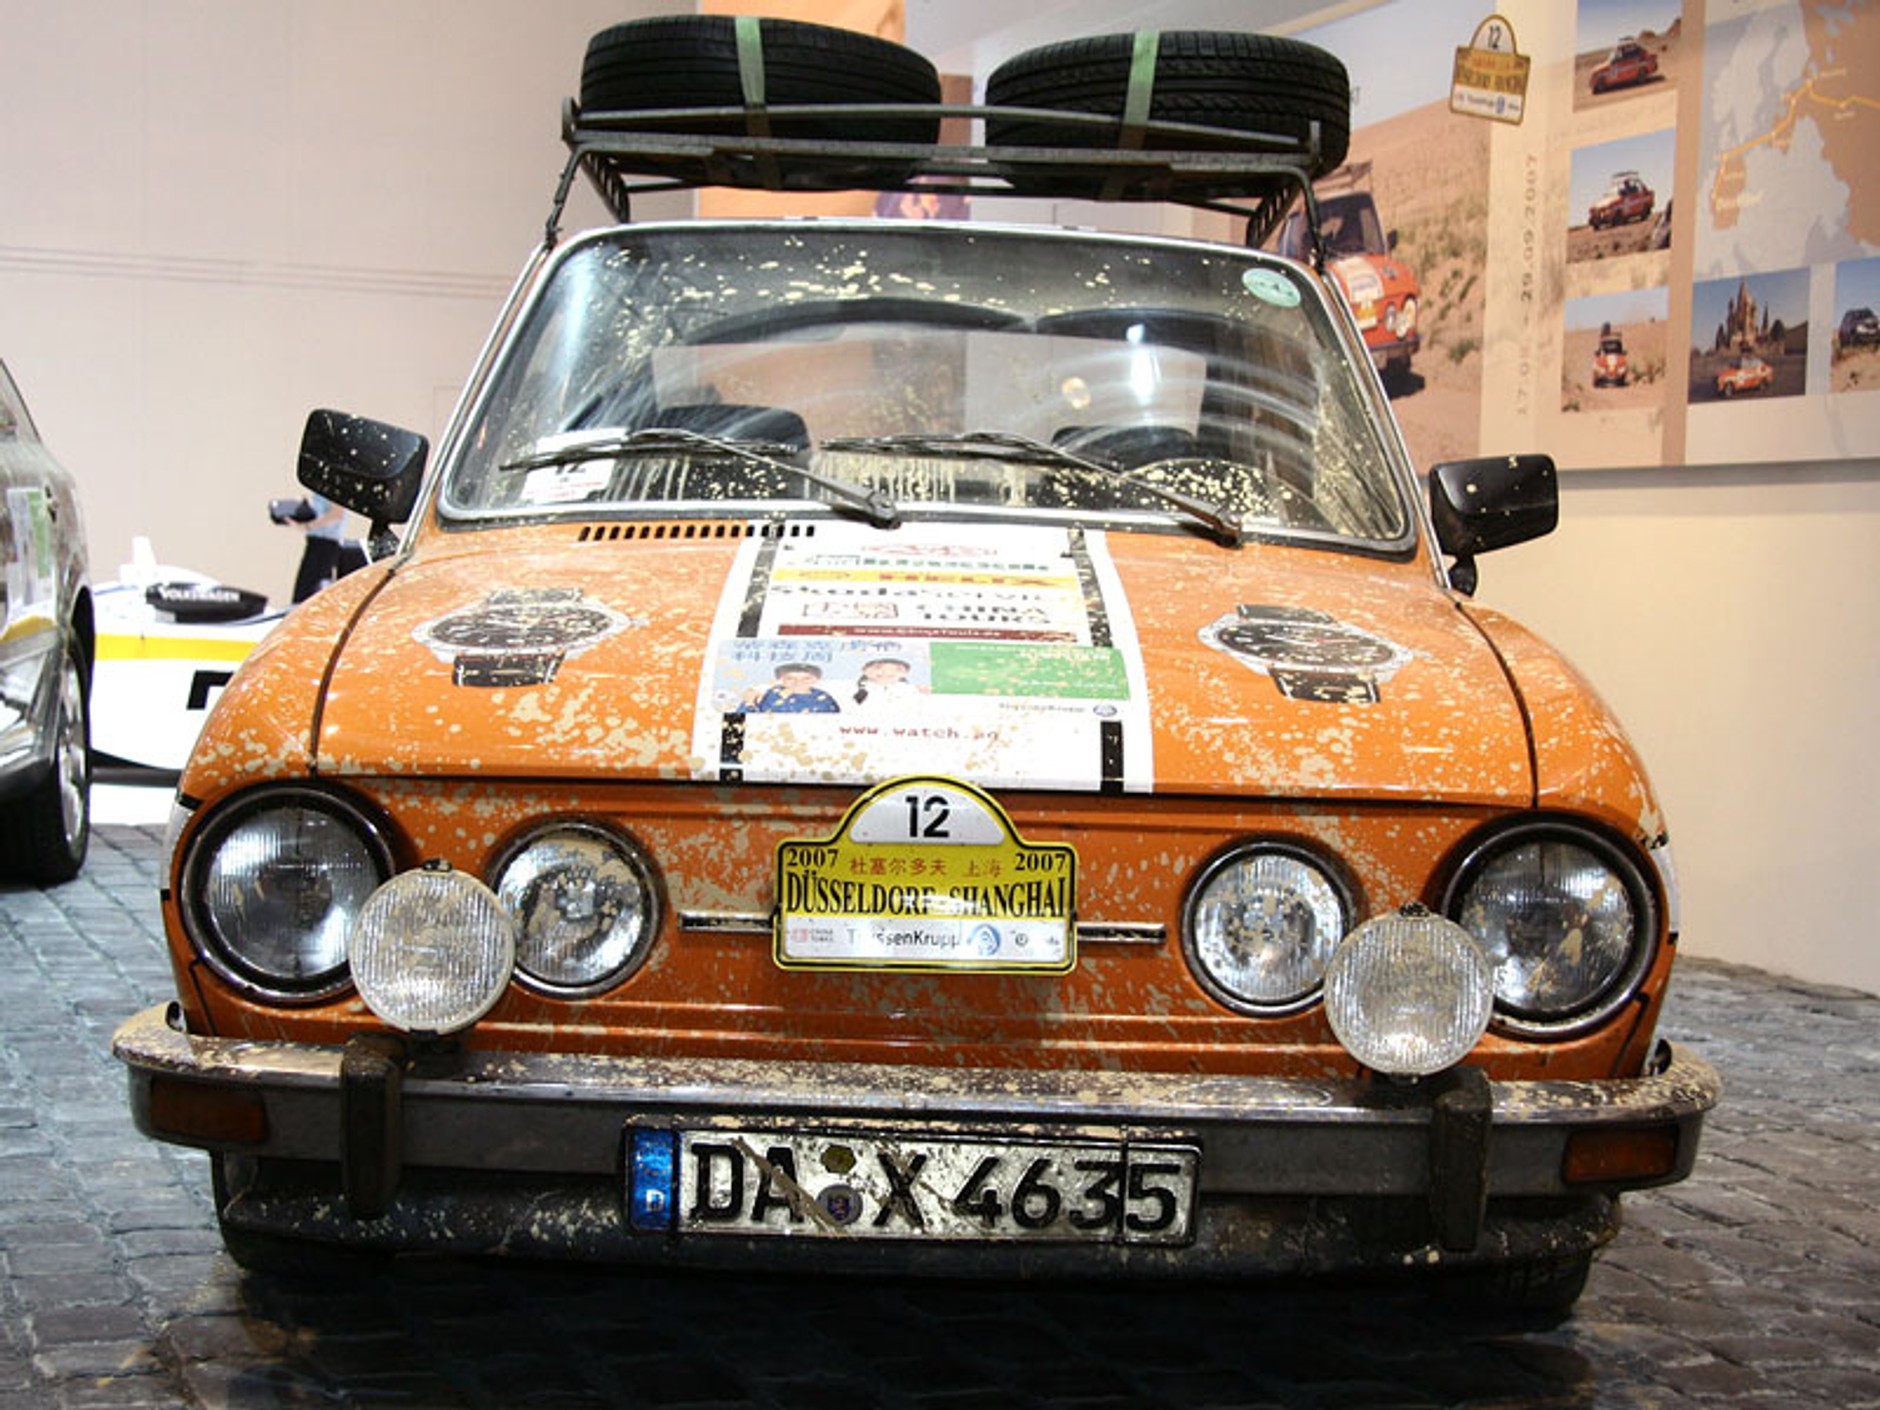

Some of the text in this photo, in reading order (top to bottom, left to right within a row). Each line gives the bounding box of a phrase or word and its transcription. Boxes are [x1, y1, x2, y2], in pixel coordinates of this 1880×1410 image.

[1488, 24, 1502, 50] 12
[905, 796, 950, 838] 12
[787, 848, 839, 868] 2007
[850, 857, 1004, 879] 杜塞尔多夫 上海
[1014, 852, 1067, 872] 2007
[787, 870, 936, 915] DÜSSELDORF
[950, 876, 1067, 918] SHANGHAI
[690, 1143, 1182, 1232] DA X 4635
